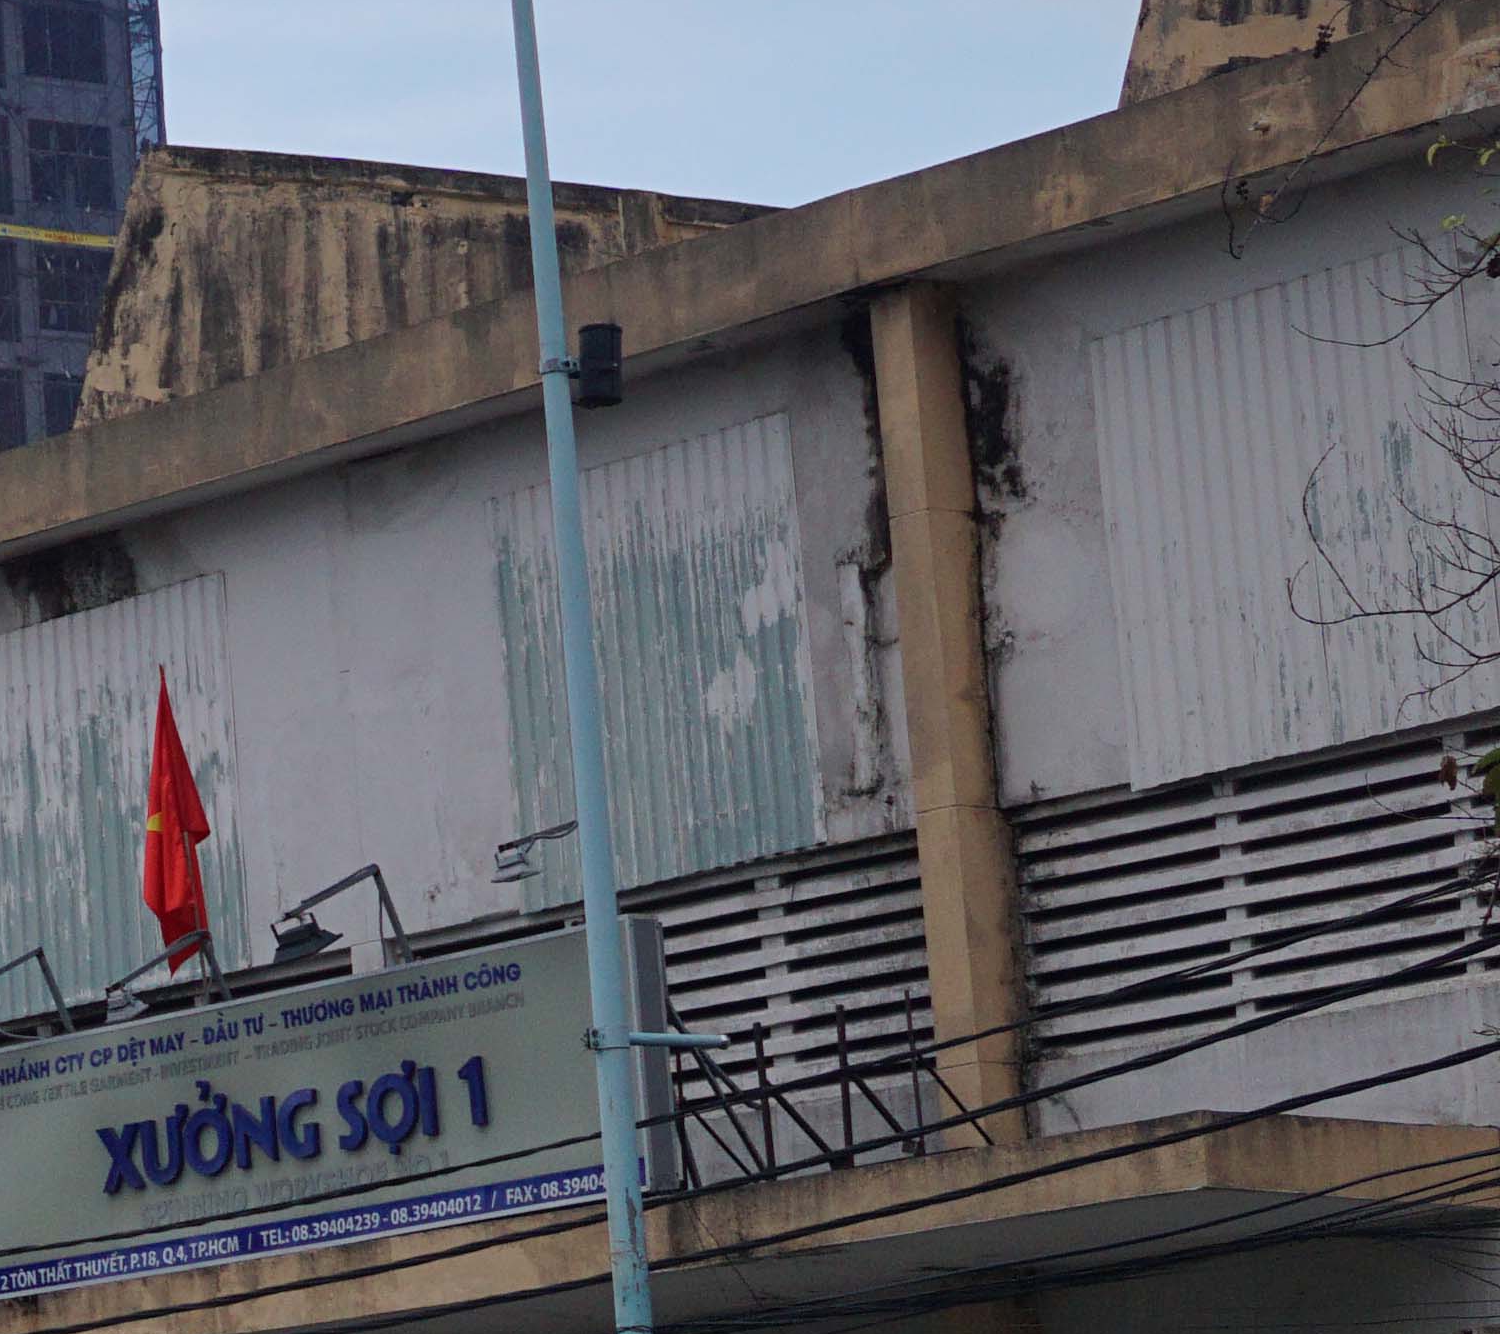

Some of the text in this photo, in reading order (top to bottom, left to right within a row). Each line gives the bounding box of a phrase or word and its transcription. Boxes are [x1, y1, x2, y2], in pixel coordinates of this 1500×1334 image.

[55, 1053, 85, 1075] CTY
[90, 1048, 113, 1068] CP
[117, 1037, 146, 1067] DỆT
[150, 1032, 185, 1055] MAY
[203, 1011, 239, 1045] ĐẦU
[244, 1013, 264, 1036] TƯ
[280, 997, 355, 1030] THƯƠNG
[359, 988, 393, 1016] MẠI
[397, 974, 458, 1005] THÀNH
[464, 962, 521, 992] CÔNG
[356, 1019, 396, 1040] STOCK
[95, 1055, 489, 1194] XƯỞNG SỢI 1
[0, 1278, 10, 1291] 2
[10, 1268, 38, 1289] TÔN
[40, 1258, 71, 1285] THẤT
[73, 1251, 129, 1279] THUYẾT,
[162, 1246, 188, 1265] Q.4,
[189, 1235, 239, 1259] TP.HCM
[391, 1194, 482, 1225] 08.39404012
[541, 1173, 608, 1198] 08.39404
